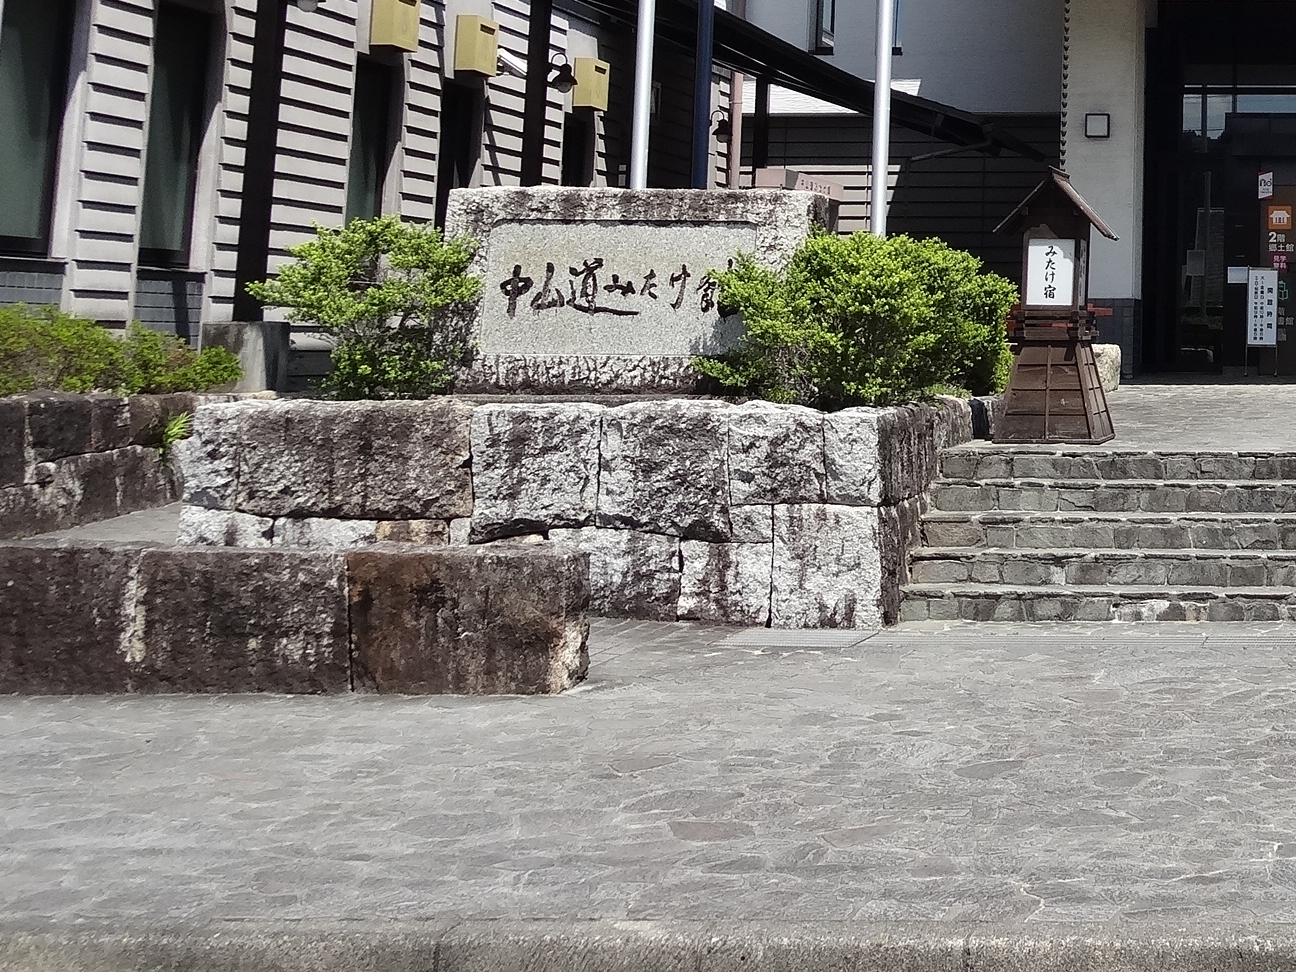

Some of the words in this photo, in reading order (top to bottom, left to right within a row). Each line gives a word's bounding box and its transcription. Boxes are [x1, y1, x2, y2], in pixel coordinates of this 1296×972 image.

[1268, 231, 1286, 243] 2階
[1268, 243, 1295, 252] 郷土館
[1044, 245, 1058, 300] みたけ宿
